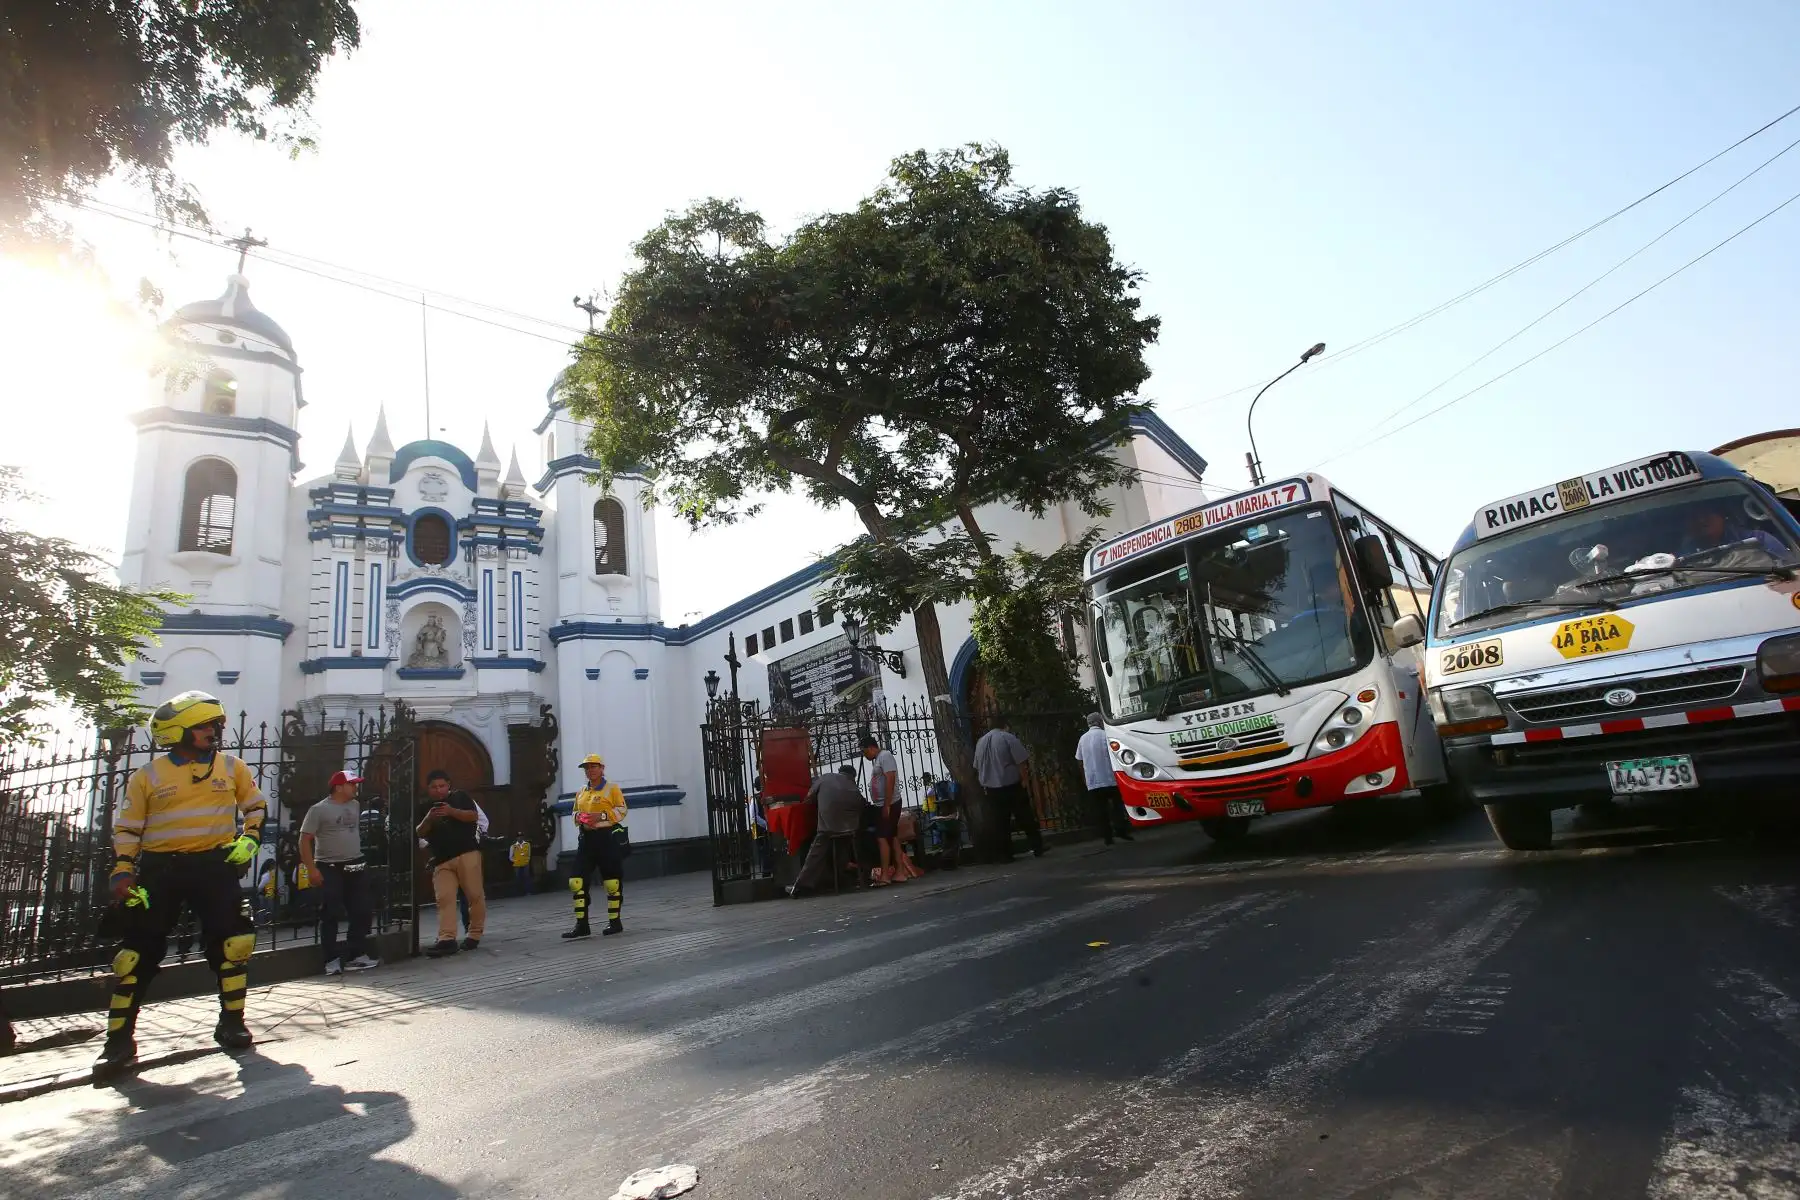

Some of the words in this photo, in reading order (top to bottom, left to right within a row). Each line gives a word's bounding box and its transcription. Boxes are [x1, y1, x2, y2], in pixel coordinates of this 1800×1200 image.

[1585, 475, 1614, 499] LA
[1612, 453, 1698, 492] VICTORIA
[1205, 503, 1235, 526] VILLA
[1281, 484, 1298, 502] 7
[1562, 487, 1586, 506] 2608
[1484, 491, 1558, 528] RIMAC
[1176, 513, 1203, 535] 2803
[1097, 549, 1109, 566] 7
[1109, 525, 1173, 561] INDEPENDENCIA
[1556, 633, 1574, 648] LA
[1580, 624, 1621, 644] BALA
[1580, 643, 1609, 653] S.A.
[1443, 645, 1500, 673] 2608
[1181, 702, 1256, 725] YUEJIN
[1169, 732, 1186, 744] E.T.
[1188, 730, 1199, 742] 17
[1200, 727, 1214, 739] DE
[1215, 714, 1275, 736] NOVIEMBRE
[1615, 764, 1692, 788] A4J-738
[1147, 796, 1171, 808] 2803
